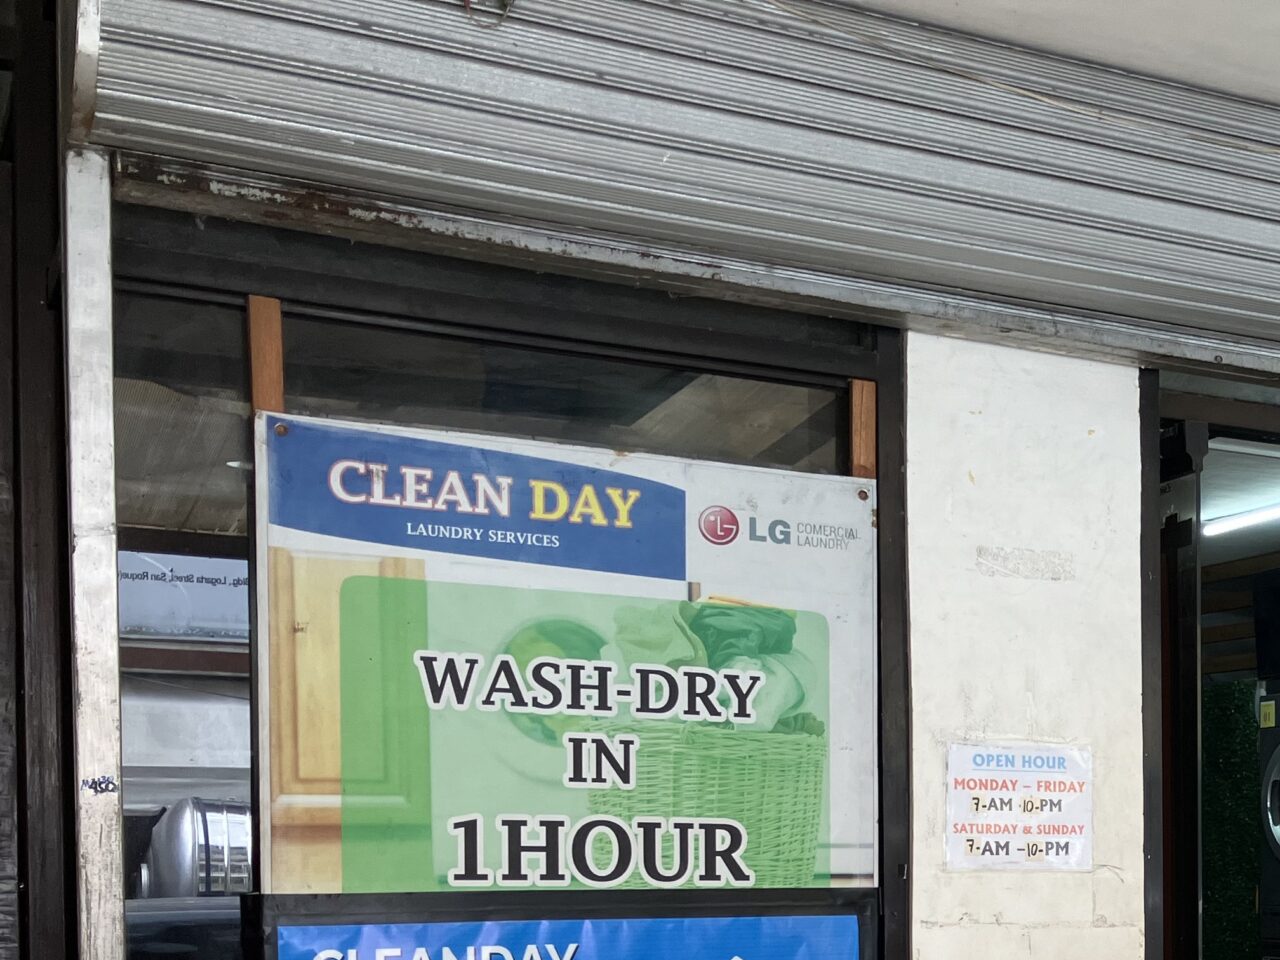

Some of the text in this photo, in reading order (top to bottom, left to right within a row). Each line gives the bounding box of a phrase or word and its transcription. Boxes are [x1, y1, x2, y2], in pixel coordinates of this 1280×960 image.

[328, 459, 641, 529] CLEAN DAY
[406, 522, 561, 549] LAUNDRY SERVICES
[749, 516, 791, 545] LG
[796, 522, 861, 541] COMERCIAL
[796, 534, 850, 550] LAUNDRY
[417, 653, 763, 721] WASH-DRY
[567, 737, 636, 787] IN
[972, 753, 1067, 770] OPEN HOUR
[953, 778, 1018, 792] MONDAY
[1036, 780, 1086, 793] FRIDAY
[953, 823, 1085, 836] SATURDAY & SUNDAY
[450, 818, 753, 886] 1HOUR
